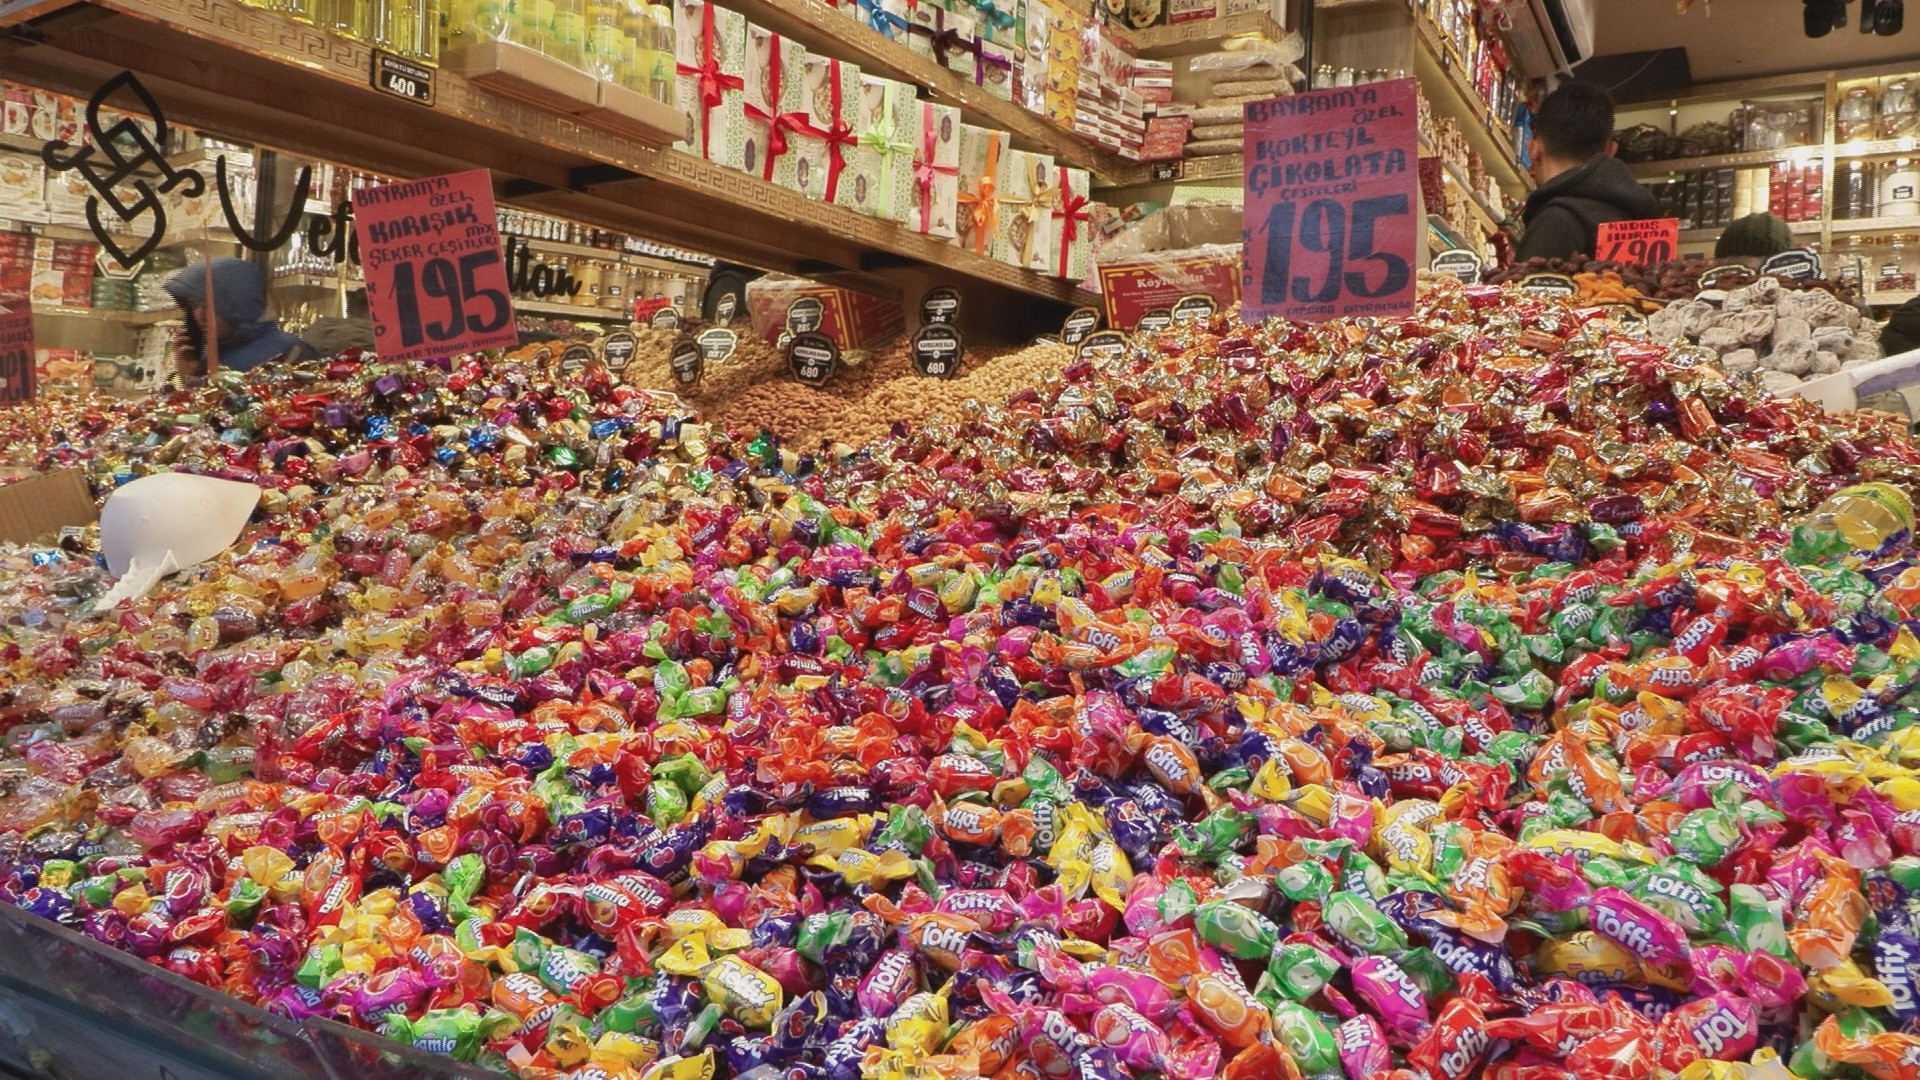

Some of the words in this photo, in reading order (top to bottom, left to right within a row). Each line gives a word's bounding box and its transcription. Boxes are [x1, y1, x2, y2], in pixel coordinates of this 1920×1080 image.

[389, 74, 415, 97] 400
[1352, 104, 1404, 125] ÖZEL
[1256, 126, 1375, 161] KOKTEYL
[1250, 148, 1406, 199] ÇİKOLATA
[429, 190, 474, 208] ÖZEL
[368, 203, 478, 244] KARIŞIK
[369, 244, 424, 270] ŞEKER
[1259, 193, 1409, 305] 195
[506, 236, 582, 297] ltan
[389, 249, 510, 347] 195
[801, 366, 819, 378] 680
[927, 362, 945, 374] 680
[1563, 604, 1595, 627] Toffi
[1086, 626, 1123, 651] Toffi
[1648, 669, 1694, 686] offix
[1390, 765, 1432, 782] Toffi
[943, 809, 986, 835] Toffi
[921, 922, 966, 953] Toffi
[1594, 905, 1664, 960] Toffix
[1434, 934, 1490, 977] Toffi
[506, 973, 550, 1006] Toffi
[866, 951, 912, 996] Toffi
[1376, 954, 1420, 1009] Toffi
[1440, 1026, 1490, 1073] Toffix
[1694, 1007, 1748, 1059] Toff
